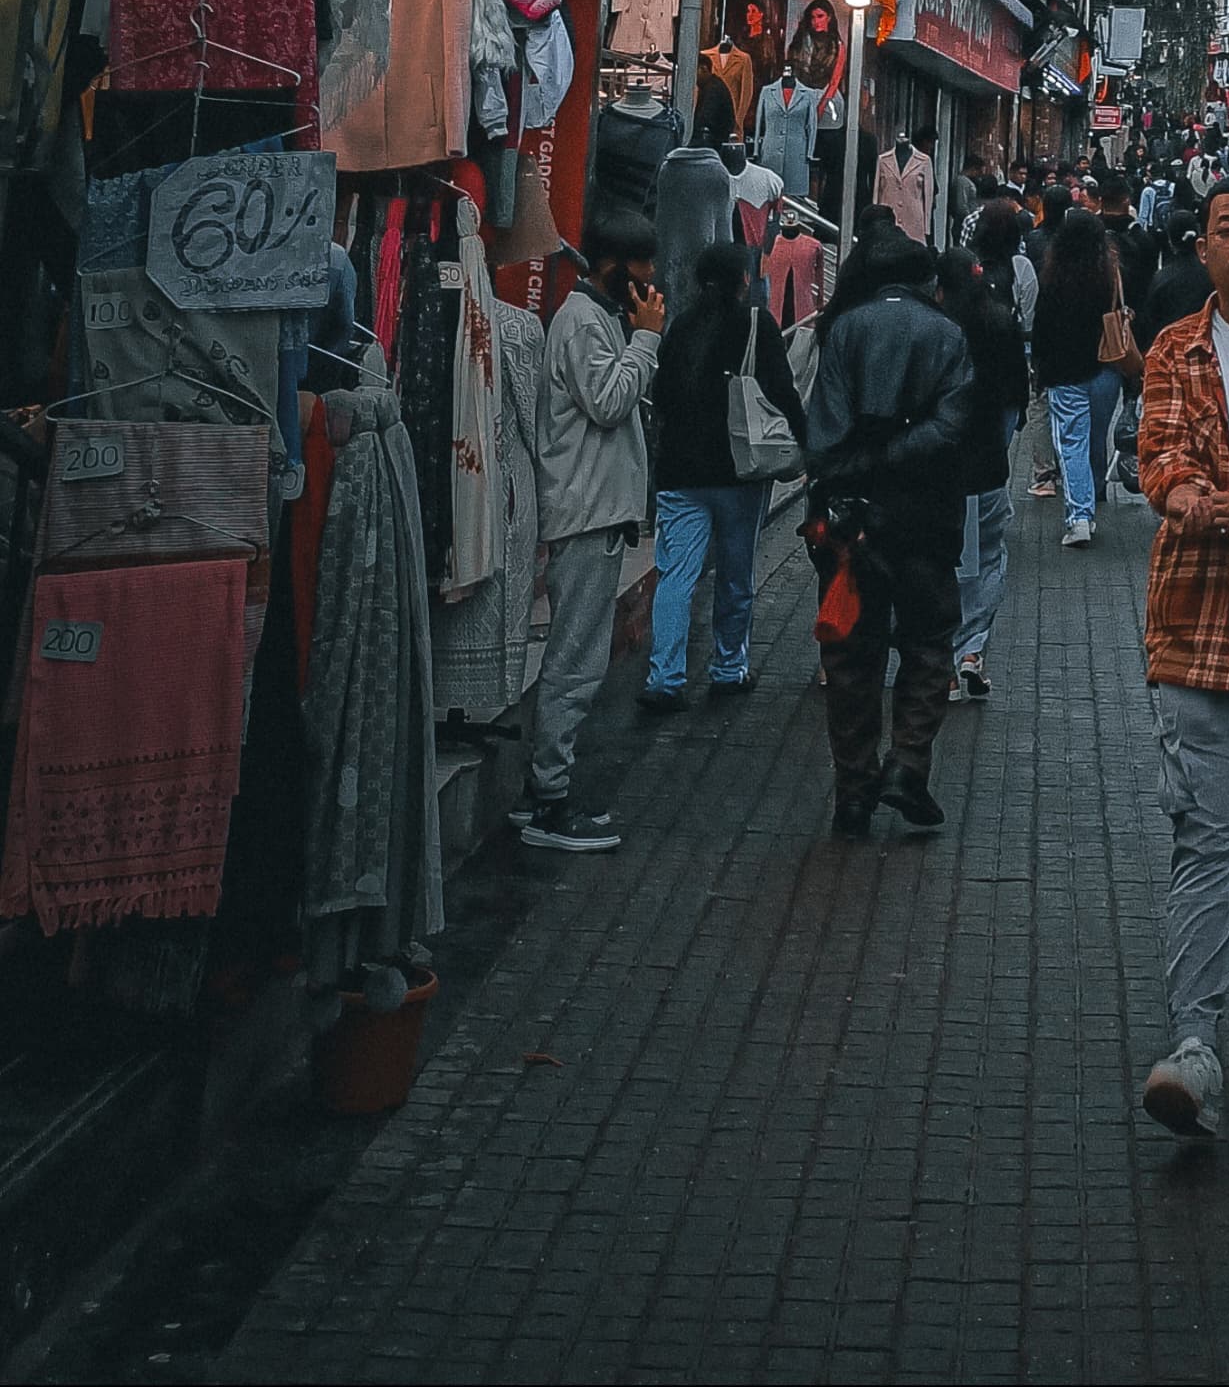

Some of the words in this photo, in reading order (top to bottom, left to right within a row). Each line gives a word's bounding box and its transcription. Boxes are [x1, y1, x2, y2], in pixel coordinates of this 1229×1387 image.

[172, 179, 318, 274] 60%
[90, 301, 131, 324] 100
[65, 444, 120, 473] 200
[42, 627, 95, 655] 200
